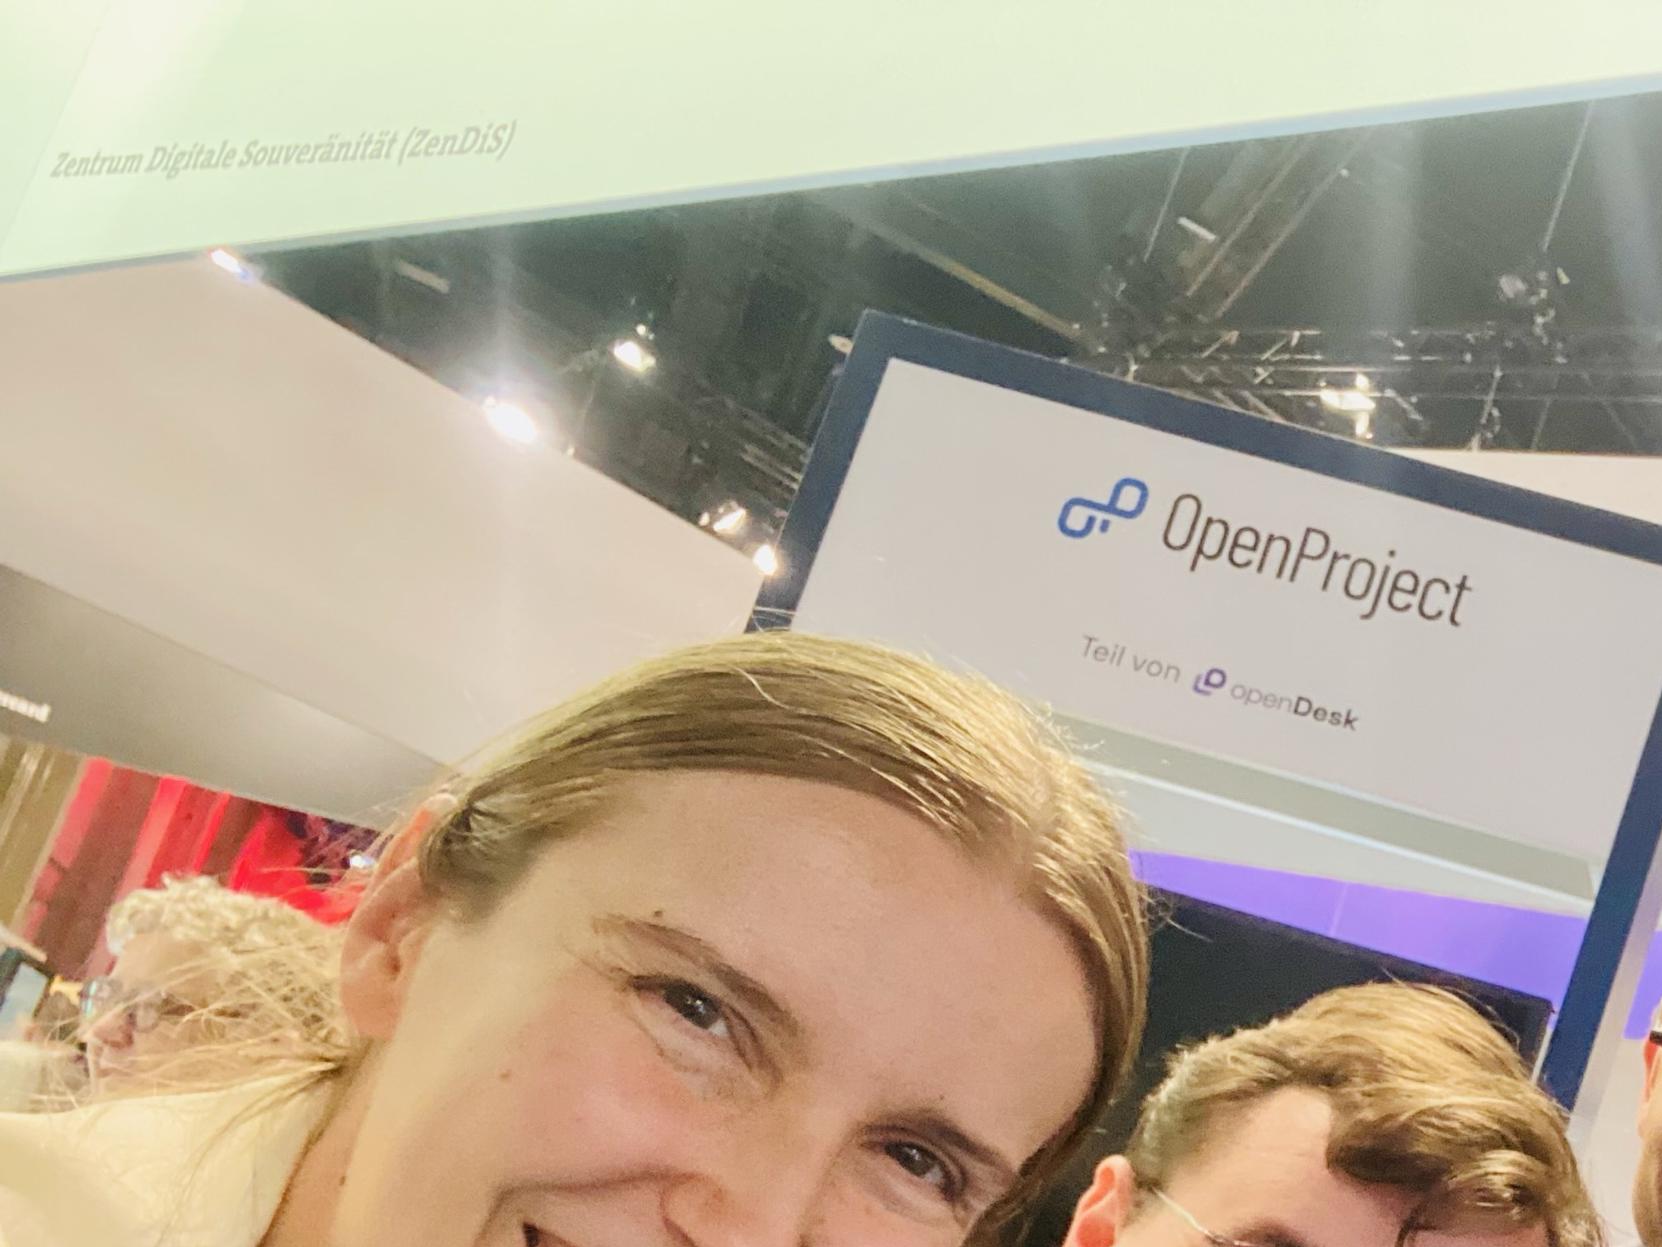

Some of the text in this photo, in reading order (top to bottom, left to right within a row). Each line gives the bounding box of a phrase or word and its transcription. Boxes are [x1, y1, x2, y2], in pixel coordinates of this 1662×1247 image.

[50, 119, 517, 180] Zentrum Digitale Souveränität (ZenDiS)
[1162, 493, 1475, 627] OpenProject
[1082, 634, 1360, 731] Teil von openDesk
